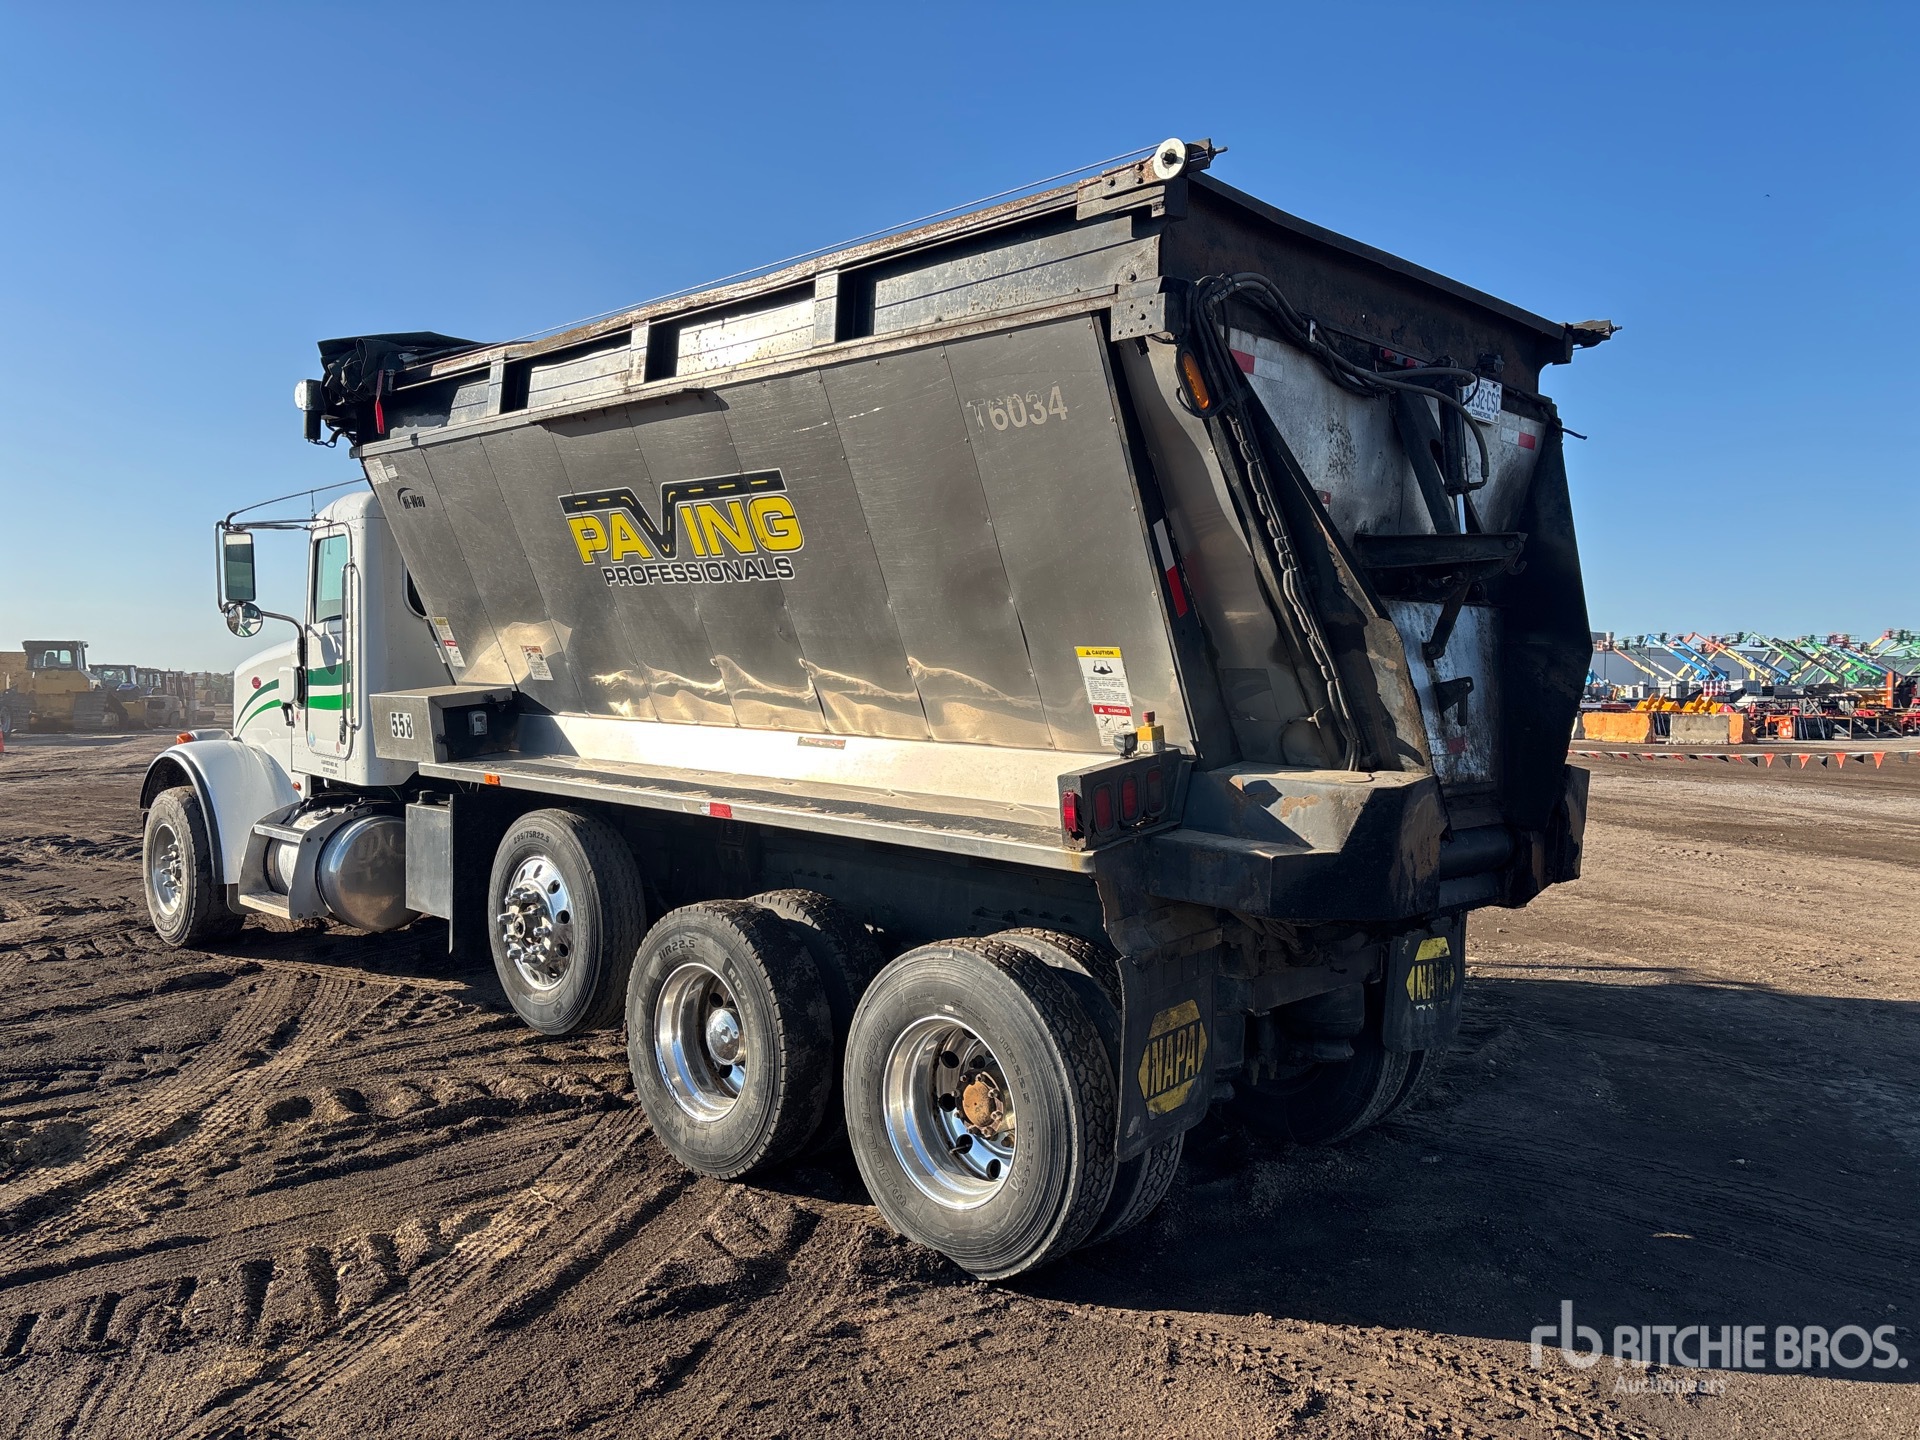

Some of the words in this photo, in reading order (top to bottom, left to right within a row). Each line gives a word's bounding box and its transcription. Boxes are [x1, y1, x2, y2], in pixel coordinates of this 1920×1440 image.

[401, 494, 426, 509] Hi-Way
[558, 468, 804, 564] PAVING
[601, 557, 795, 586] PROFESSIONALS
[391, 713, 413, 738] 558
[513, 830, 550, 844] 295/75R22.5
[862, 1013, 890, 1073] COIN
[1149, 1024, 1197, 1098] NAPA
